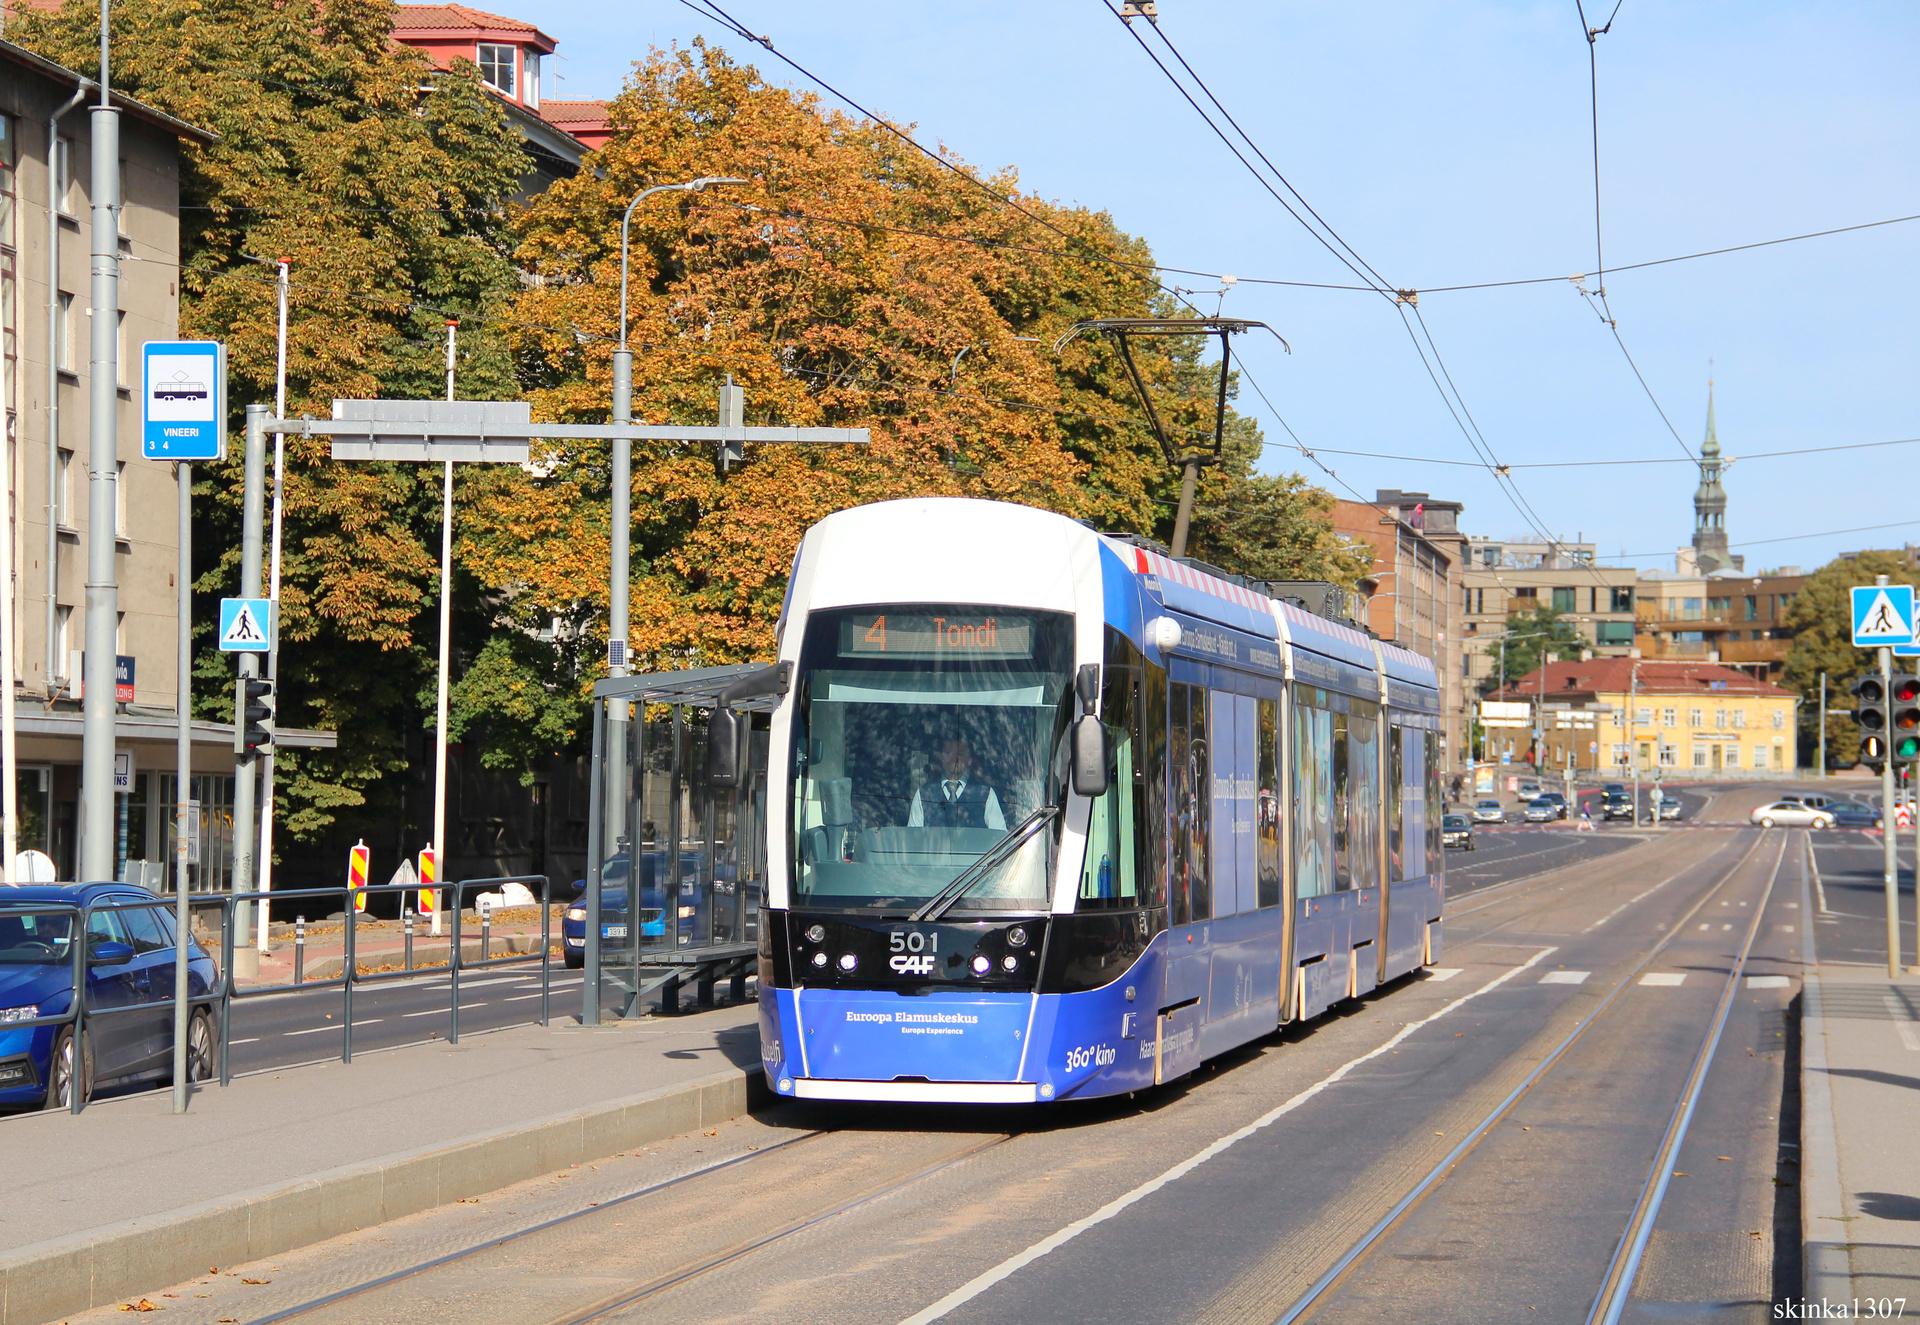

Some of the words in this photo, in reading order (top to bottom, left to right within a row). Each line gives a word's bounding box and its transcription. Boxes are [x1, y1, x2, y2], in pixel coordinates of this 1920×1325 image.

[163, 428, 199, 437] VINEERI
[149, 441, 156, 450] 3
[162, 441, 169, 450] 4
[864, 616, 887, 651] 4
[933, 617, 996, 647] Tondi
[889, 931, 938, 953] 501
[889, 955, 936, 975] CAF
[846, 1011, 893, 1024] Euroopa
[894, 1011, 979, 1024] Elamuskeskus
[901, 1026, 926, 1035] Europa
[926, 1026, 964, 1035] Experience
[1095, 1042, 1116, 1067] kino
